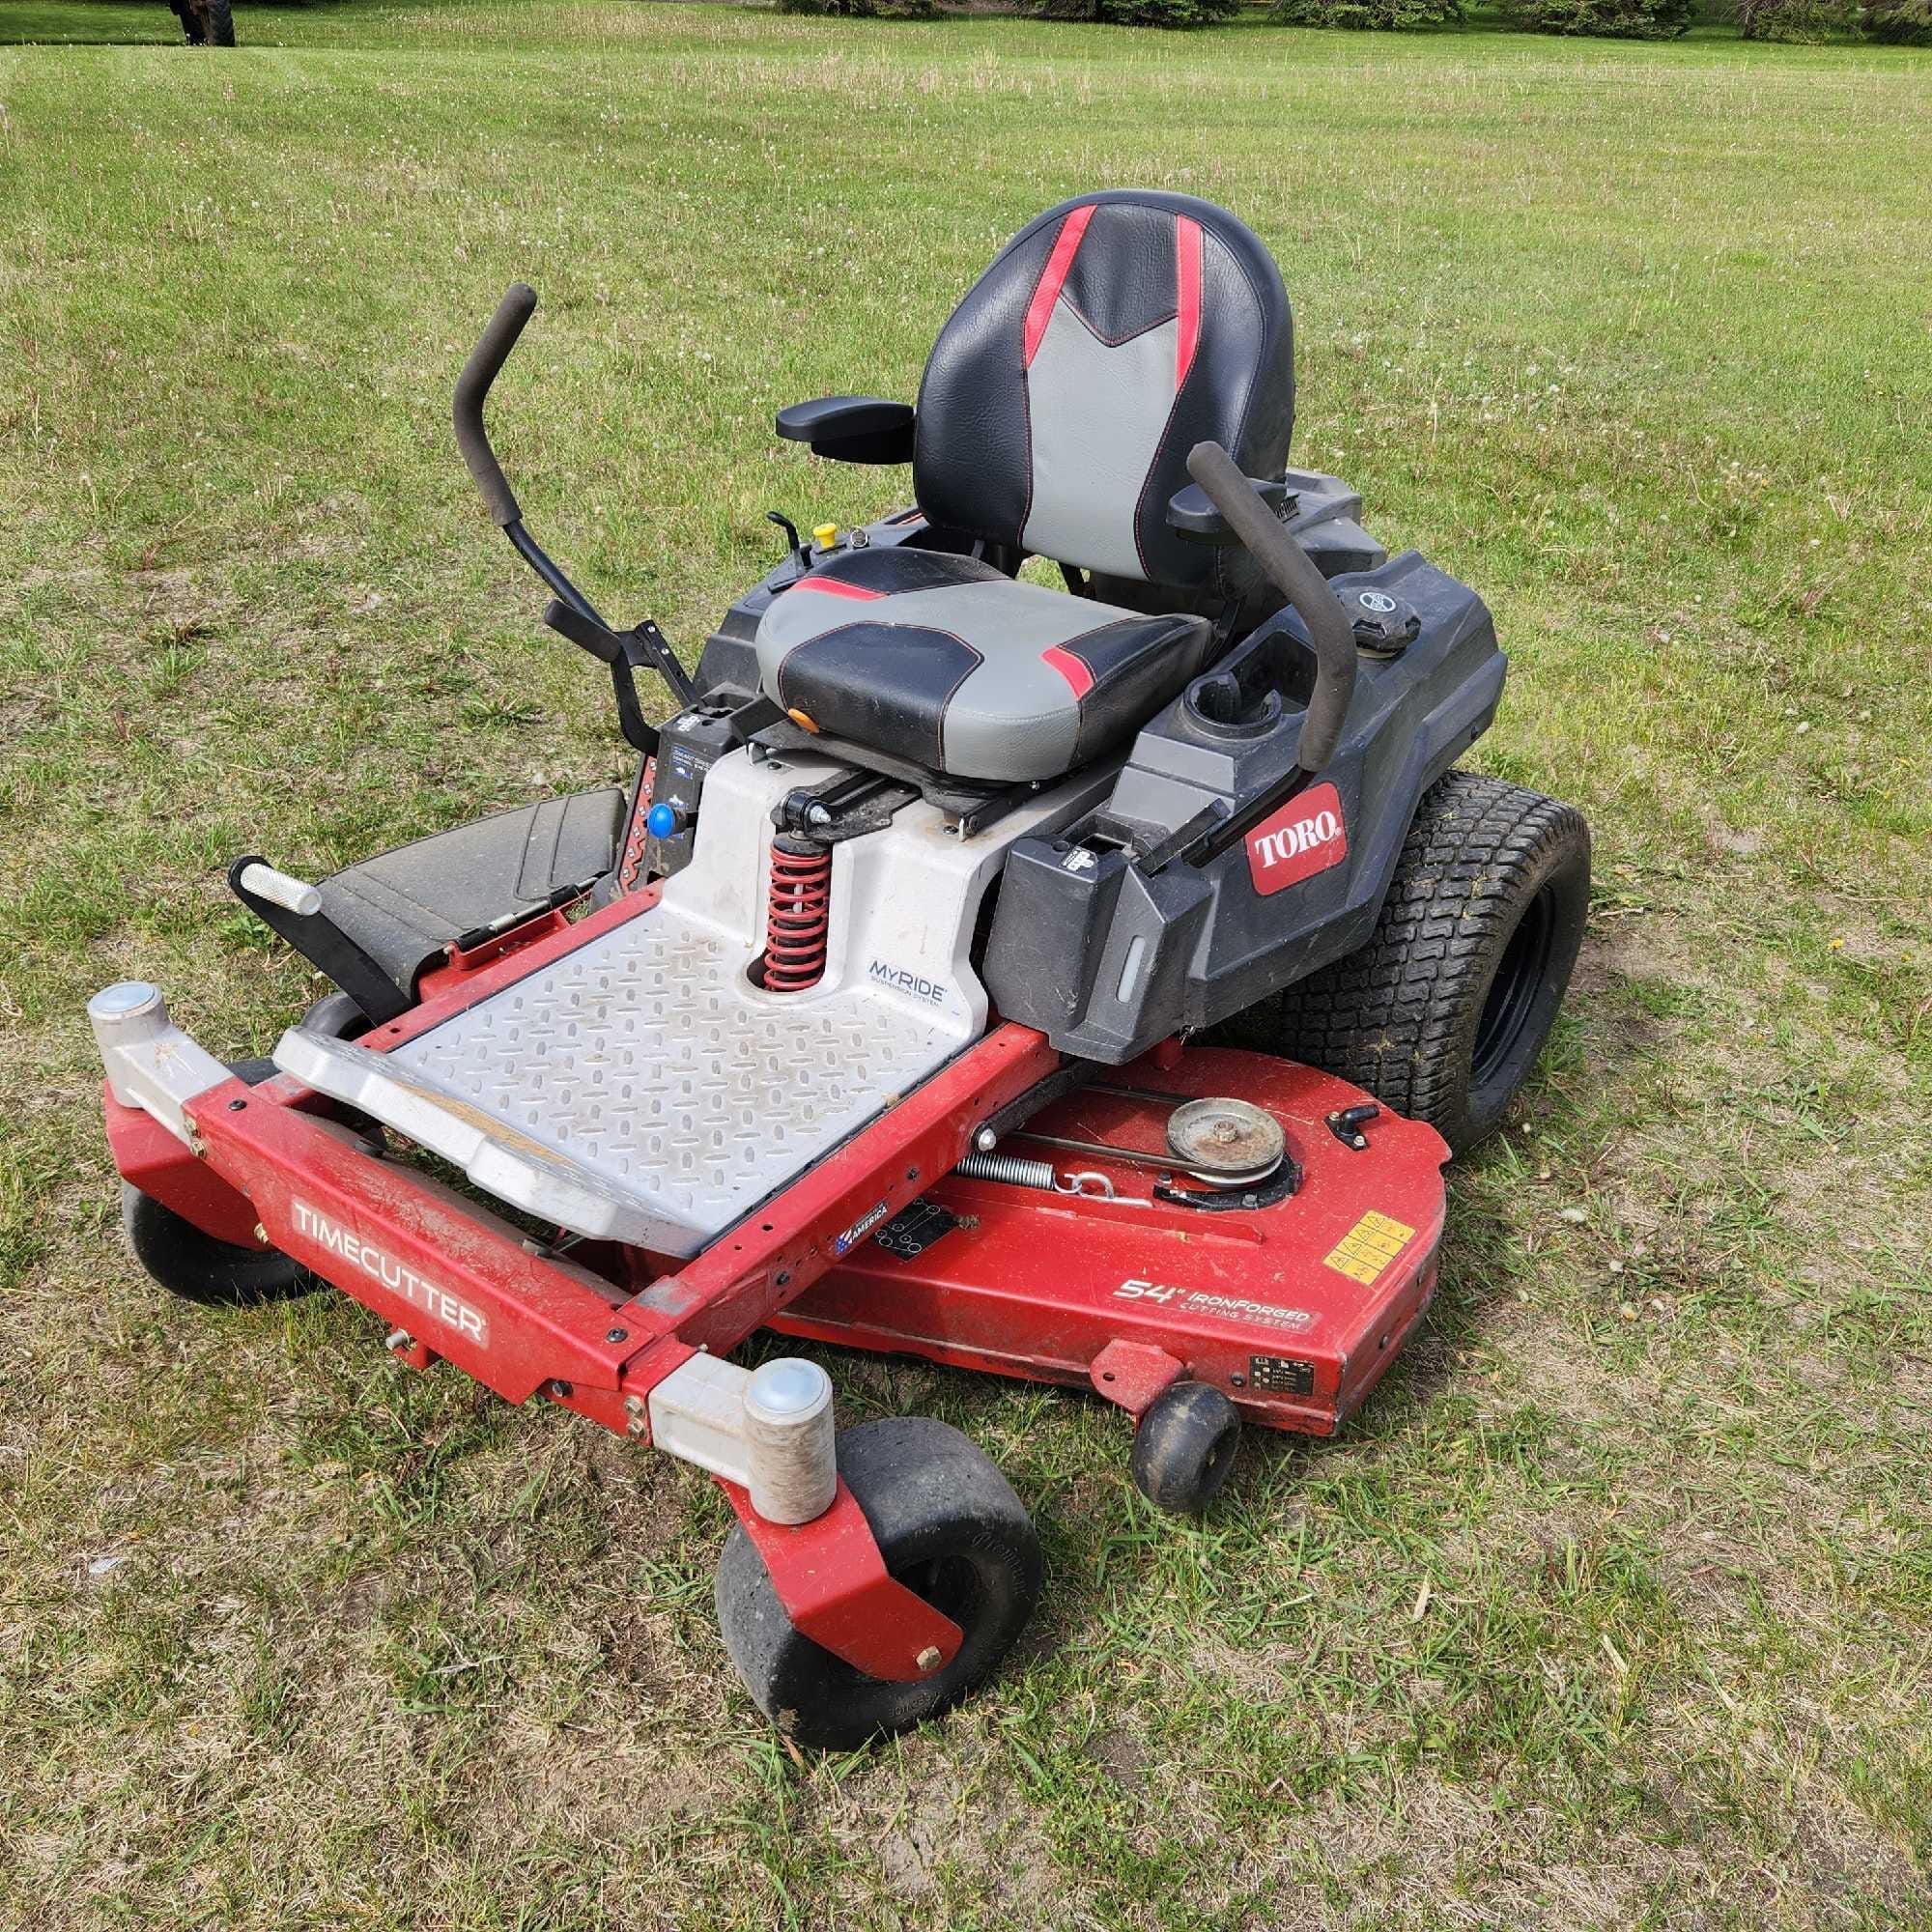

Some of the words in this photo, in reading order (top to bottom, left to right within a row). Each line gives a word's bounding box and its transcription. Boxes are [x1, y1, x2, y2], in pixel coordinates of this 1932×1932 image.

[1254, 810, 1338, 868] TORO
[868, 959, 944, 1003] MYRIDE
[852, 1206, 888, 1241] AMERICA
[294, 1203, 482, 1342] TIMECUTTER
[1179, 1302, 1239, 1320] CUTTING
[1242, 1313, 1301, 1331] SYSTEM
